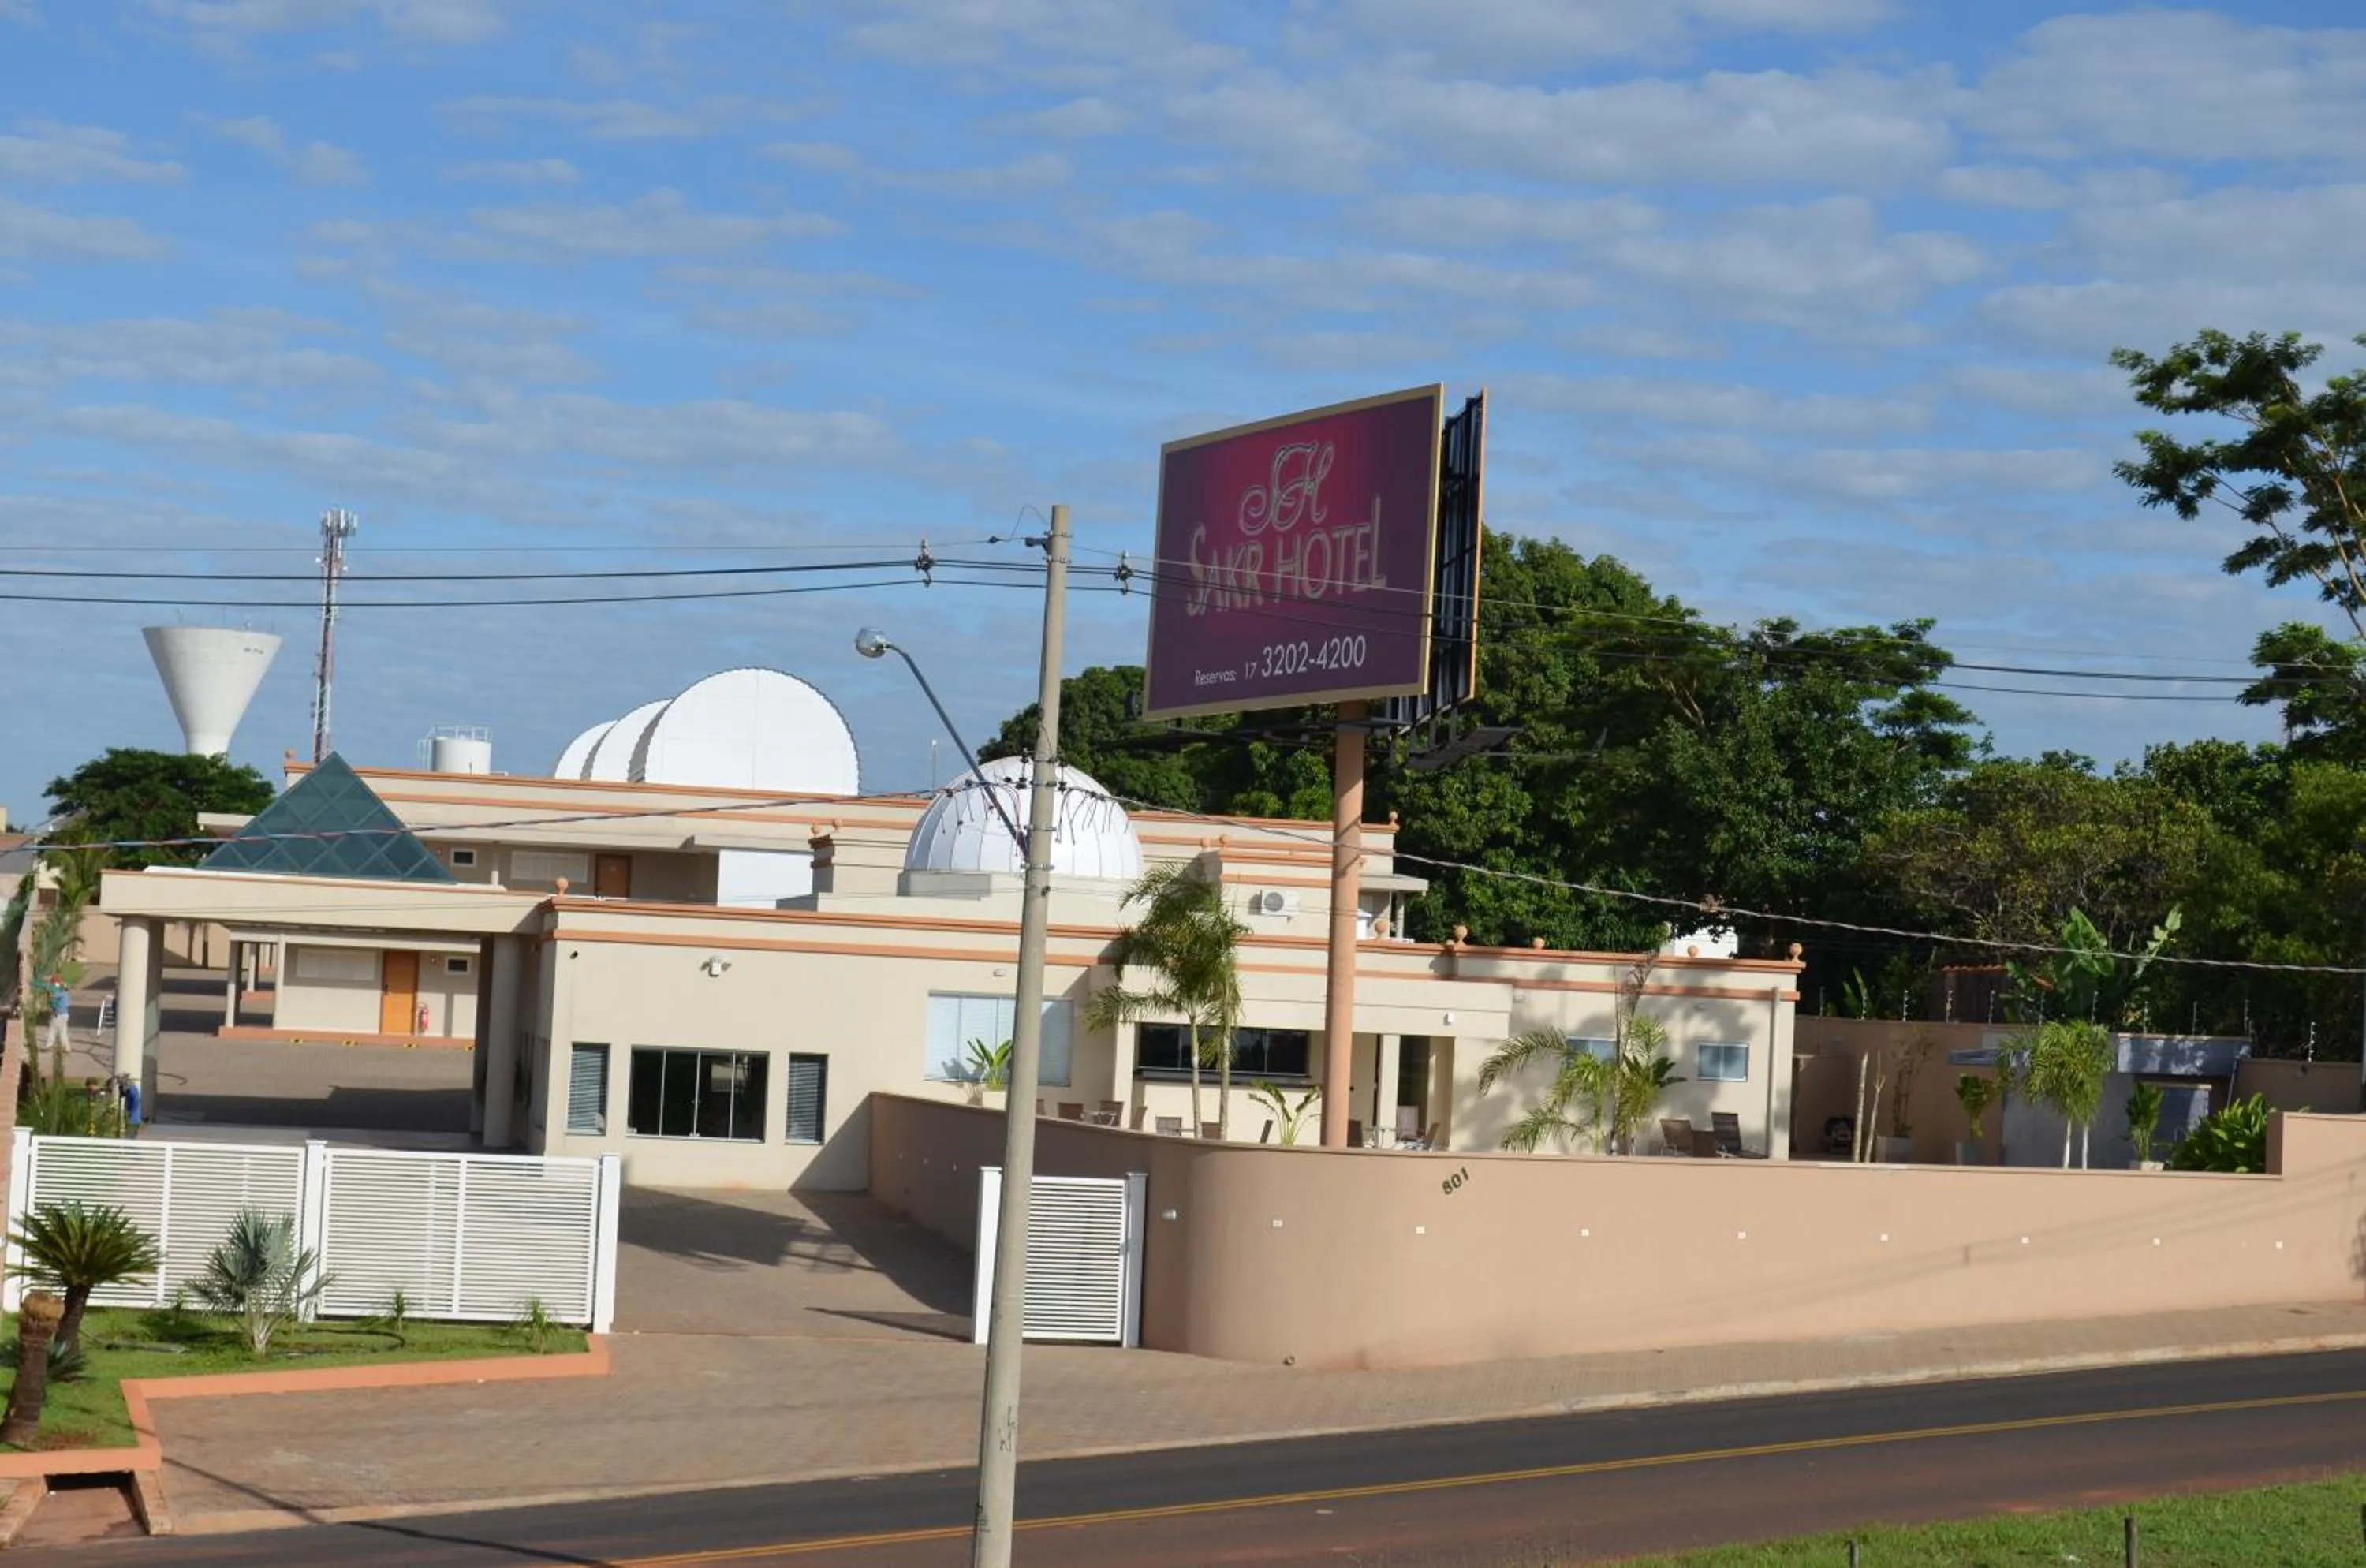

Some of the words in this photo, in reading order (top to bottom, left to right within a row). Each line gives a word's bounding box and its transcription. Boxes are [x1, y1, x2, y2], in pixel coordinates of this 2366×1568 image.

[1186, 521, 1263, 617] SAKR
[1273, 494, 1387, 603] HOTEL
[1244, 661, 1258, 680] 17
[1261, 634, 1367, 678] 3202-4200
[1442, 1166, 1469, 1195] 801
